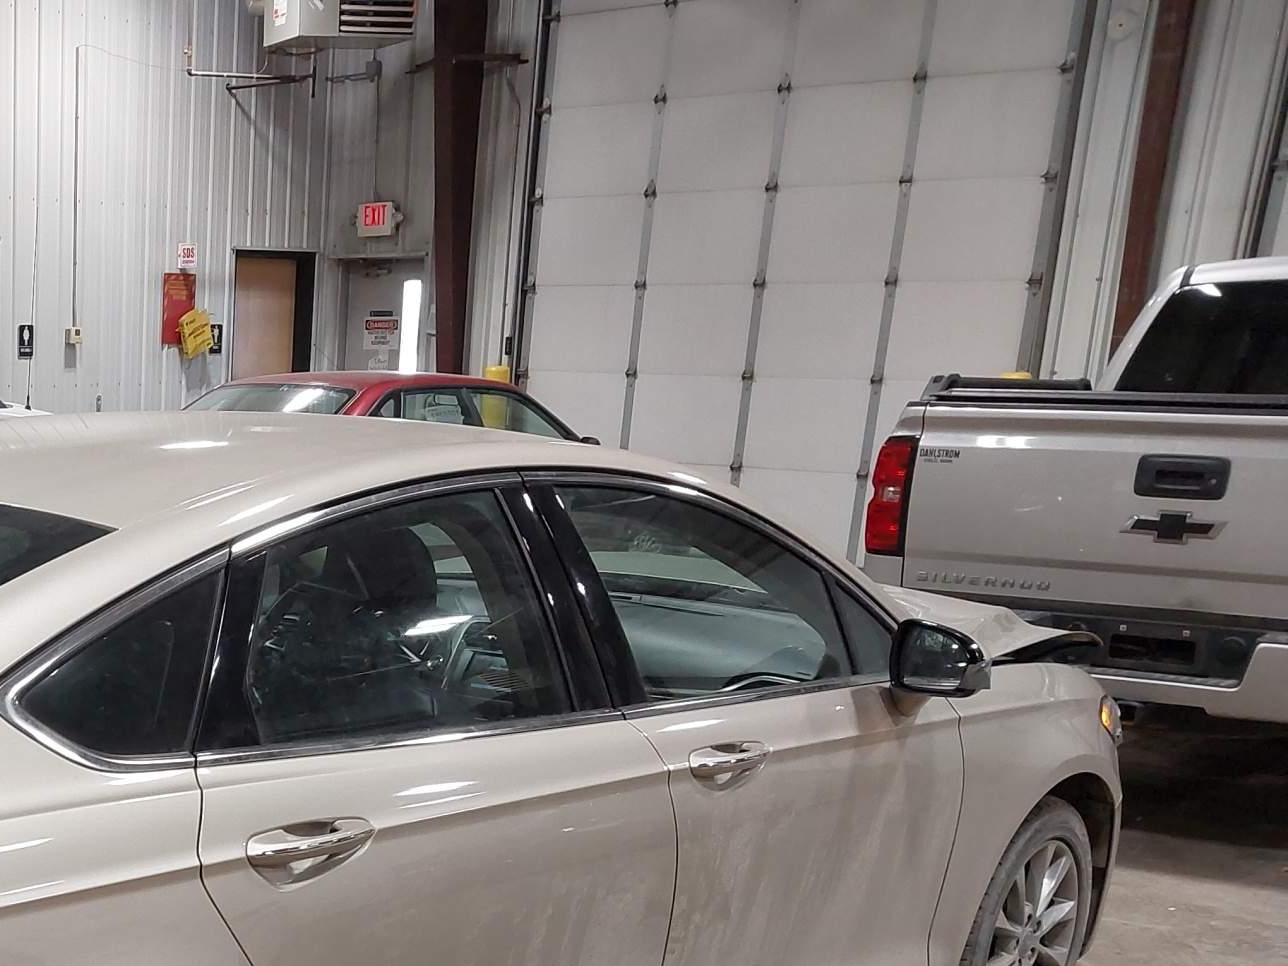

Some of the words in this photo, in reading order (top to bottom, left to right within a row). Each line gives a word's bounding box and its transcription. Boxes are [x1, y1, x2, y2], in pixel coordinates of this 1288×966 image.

[363, 204, 388, 227] EXIT
[182, 247, 195, 259] SDS
[916, 570, 1051, 592] SILVERADO
